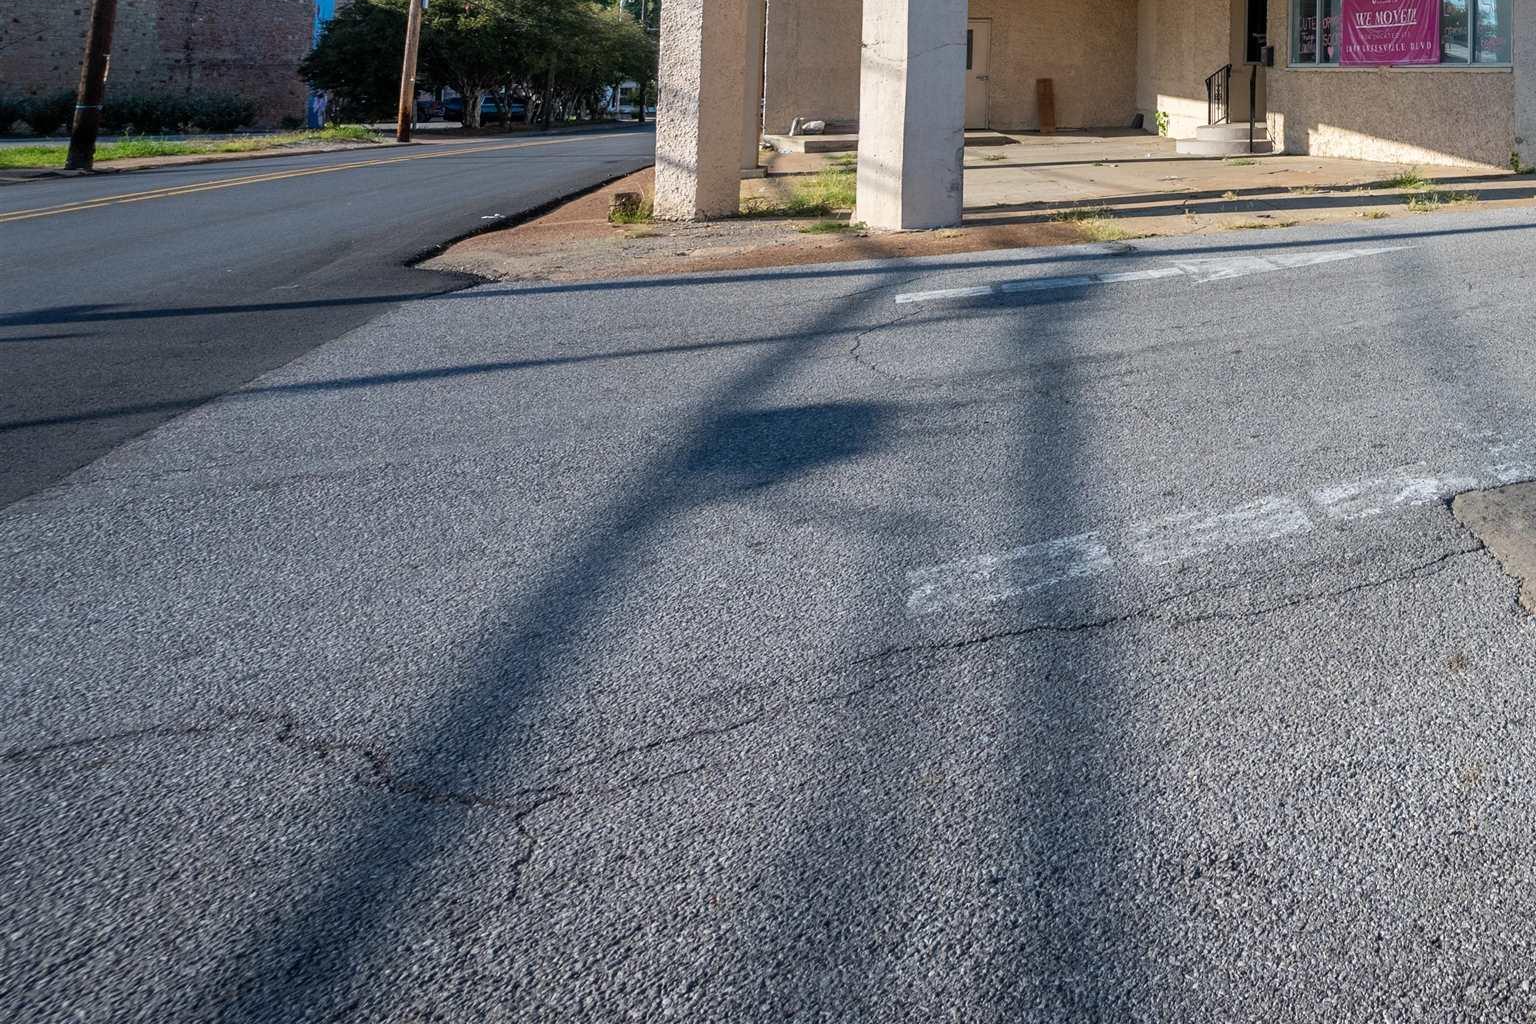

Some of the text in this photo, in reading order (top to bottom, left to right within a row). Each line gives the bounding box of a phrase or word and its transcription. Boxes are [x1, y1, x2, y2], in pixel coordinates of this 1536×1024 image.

[1356, 12, 1373, 26] WE
[1375, 8, 1417, 25] MOVED!
[1410, 41, 1432, 51] BLVD
